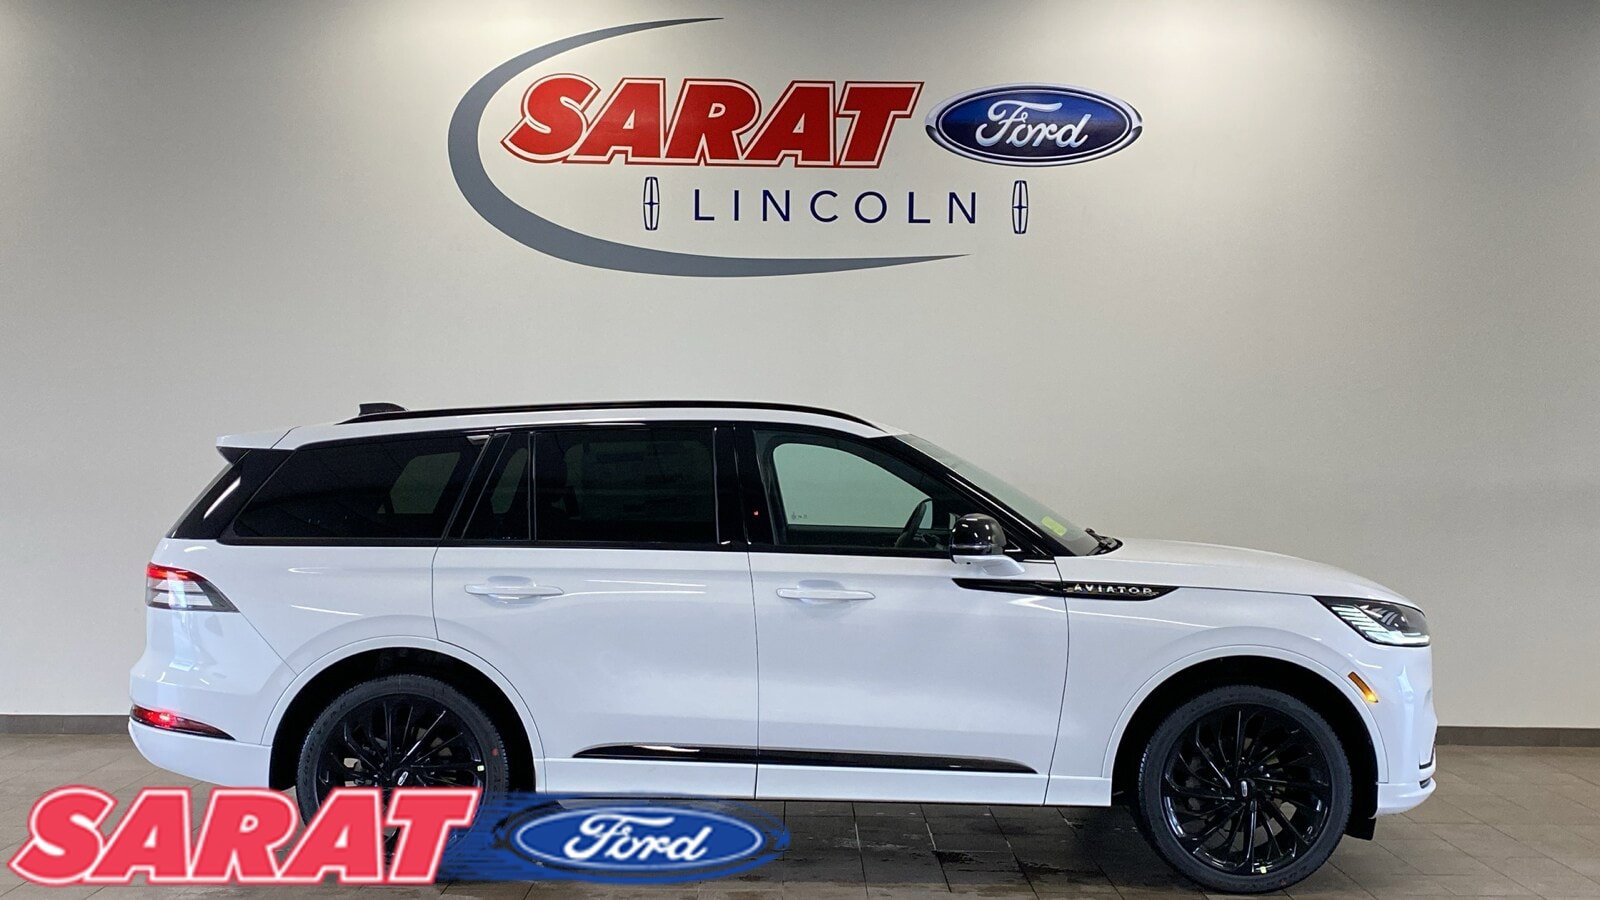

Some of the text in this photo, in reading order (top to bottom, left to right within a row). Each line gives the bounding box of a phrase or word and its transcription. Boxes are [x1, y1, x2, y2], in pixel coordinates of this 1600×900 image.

[501, 74, 1089, 168] SARAT Ford
[693, 190, 977, 224] LINCOLN
[1073, 583, 1155, 597] AVIATOR
